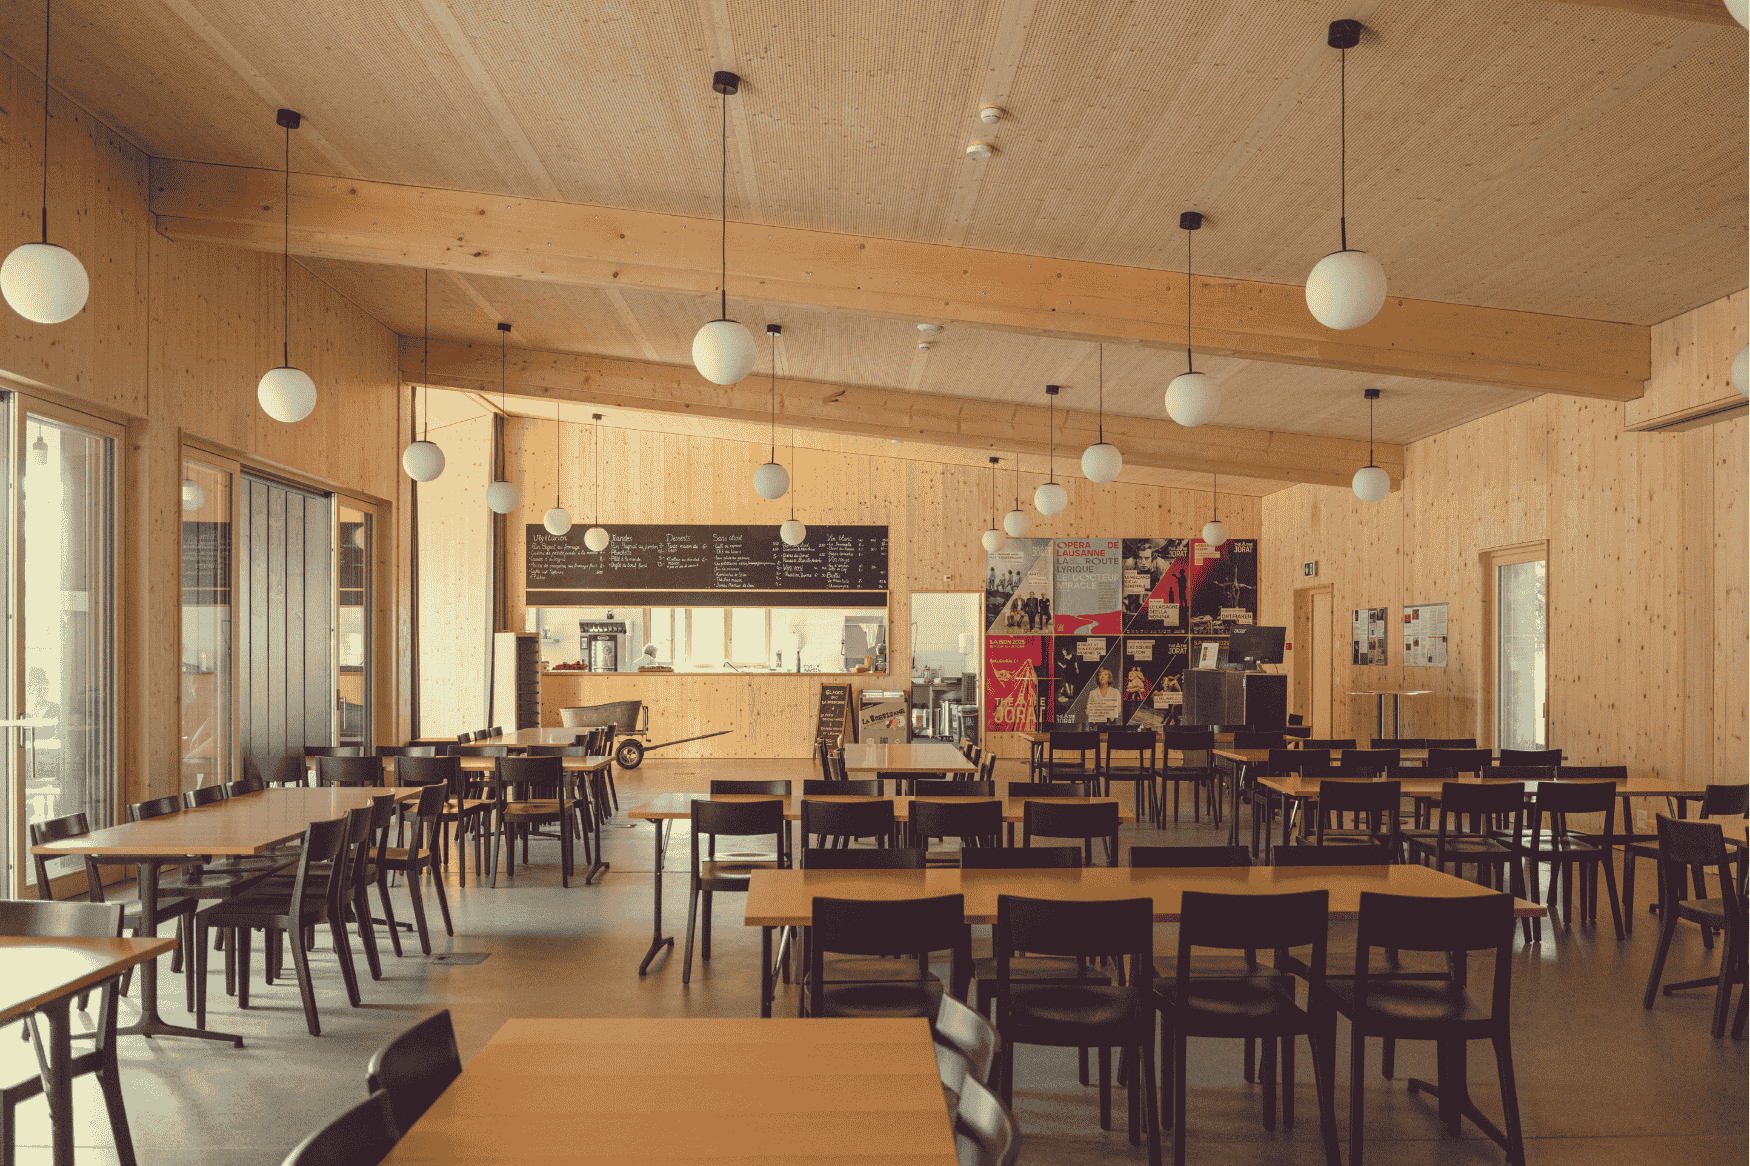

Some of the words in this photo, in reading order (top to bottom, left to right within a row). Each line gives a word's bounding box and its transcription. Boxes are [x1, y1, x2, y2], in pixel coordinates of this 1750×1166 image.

[1057, 540, 1091, 549] OPÉRA
[1107, 541, 1119, 549] DE
[1056, 549, 1106, 557] LAUSANNE
[1056, 557, 1068, 565] LA
[1085, 557, 1119, 565] ROUTE
[1056, 565, 1094, 573] LYRIQUE
[1072, 573, 1120, 581] DOCTEUR
[1057, 581, 1098, 589] MIRACLE
[993, 706, 1046, 723] JORAT
